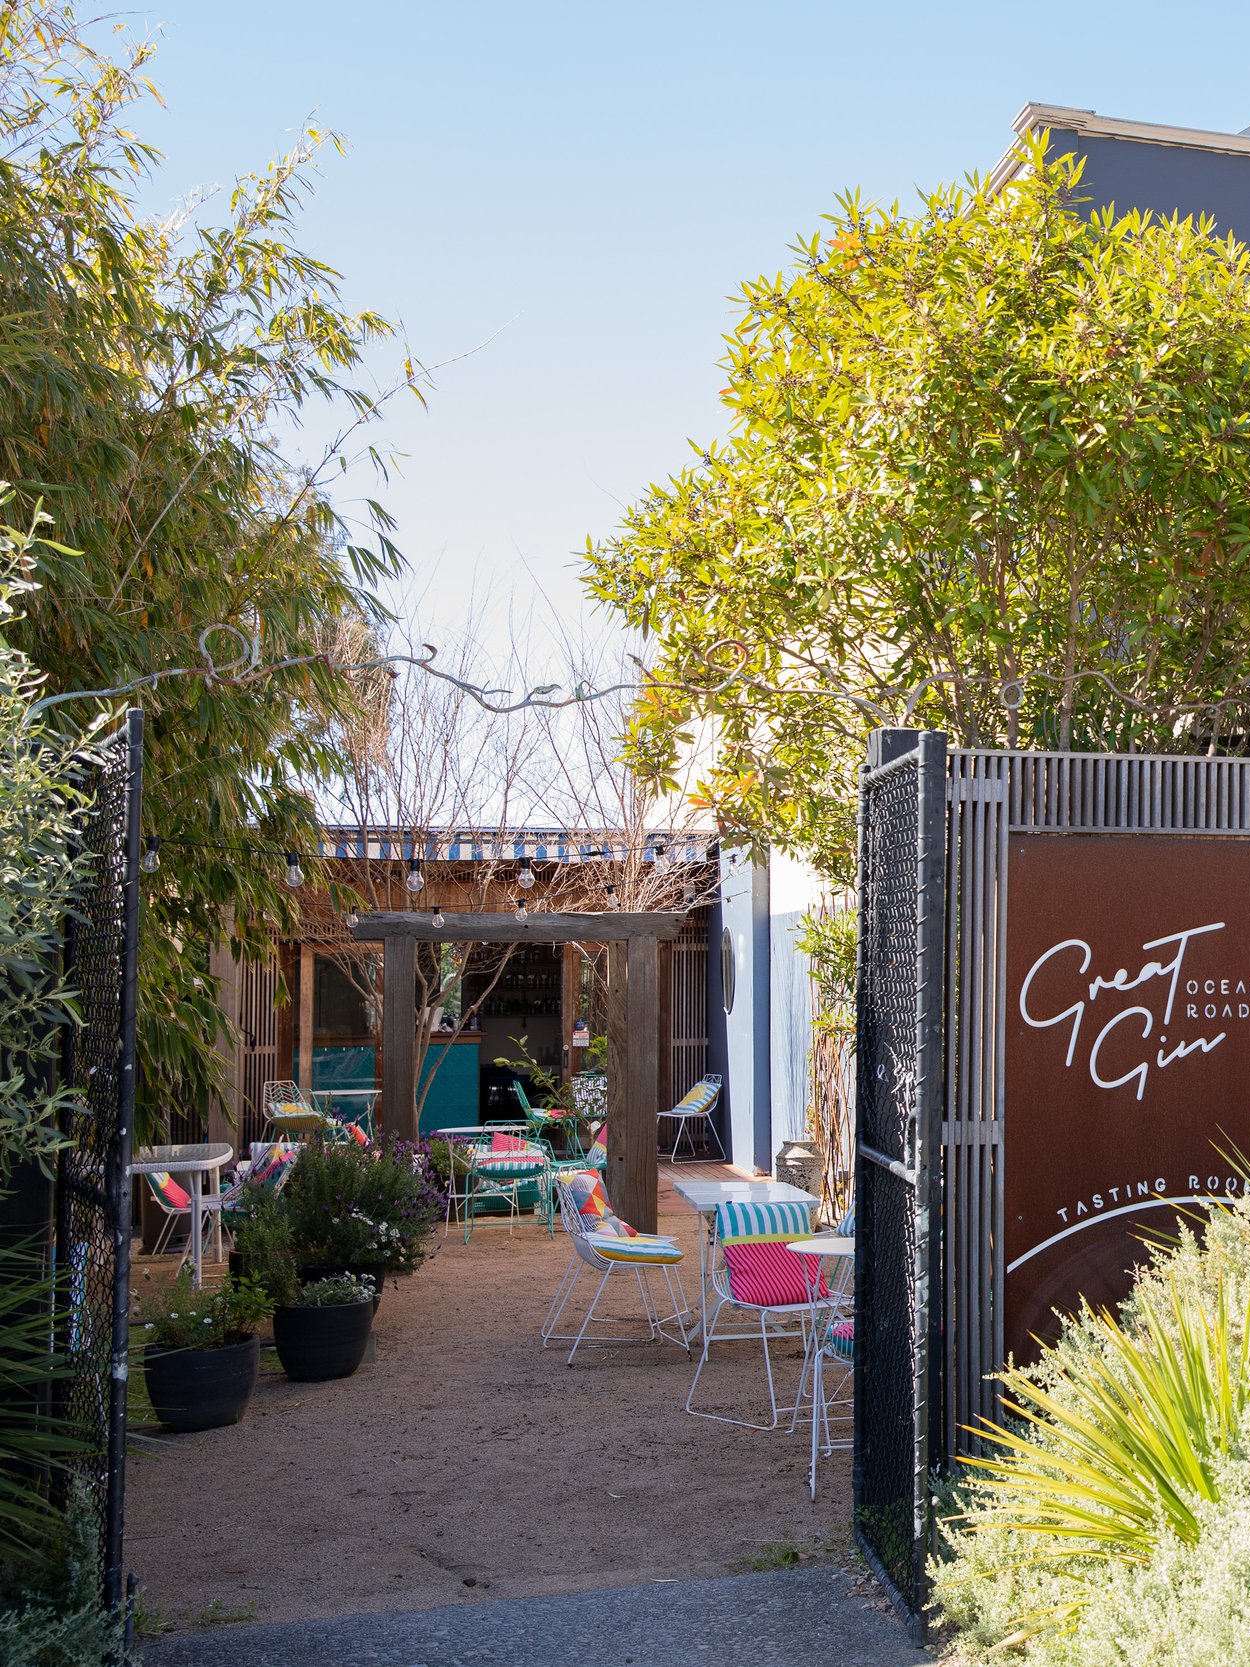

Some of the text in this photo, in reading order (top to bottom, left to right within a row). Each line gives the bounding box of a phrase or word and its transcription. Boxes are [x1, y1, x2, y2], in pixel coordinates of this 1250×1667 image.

[1186, 1003, 1250, 1019] ROAD
[1090, 1006, 1226, 1100] Gin
[1057, 1177, 1167, 1222] TASTING
